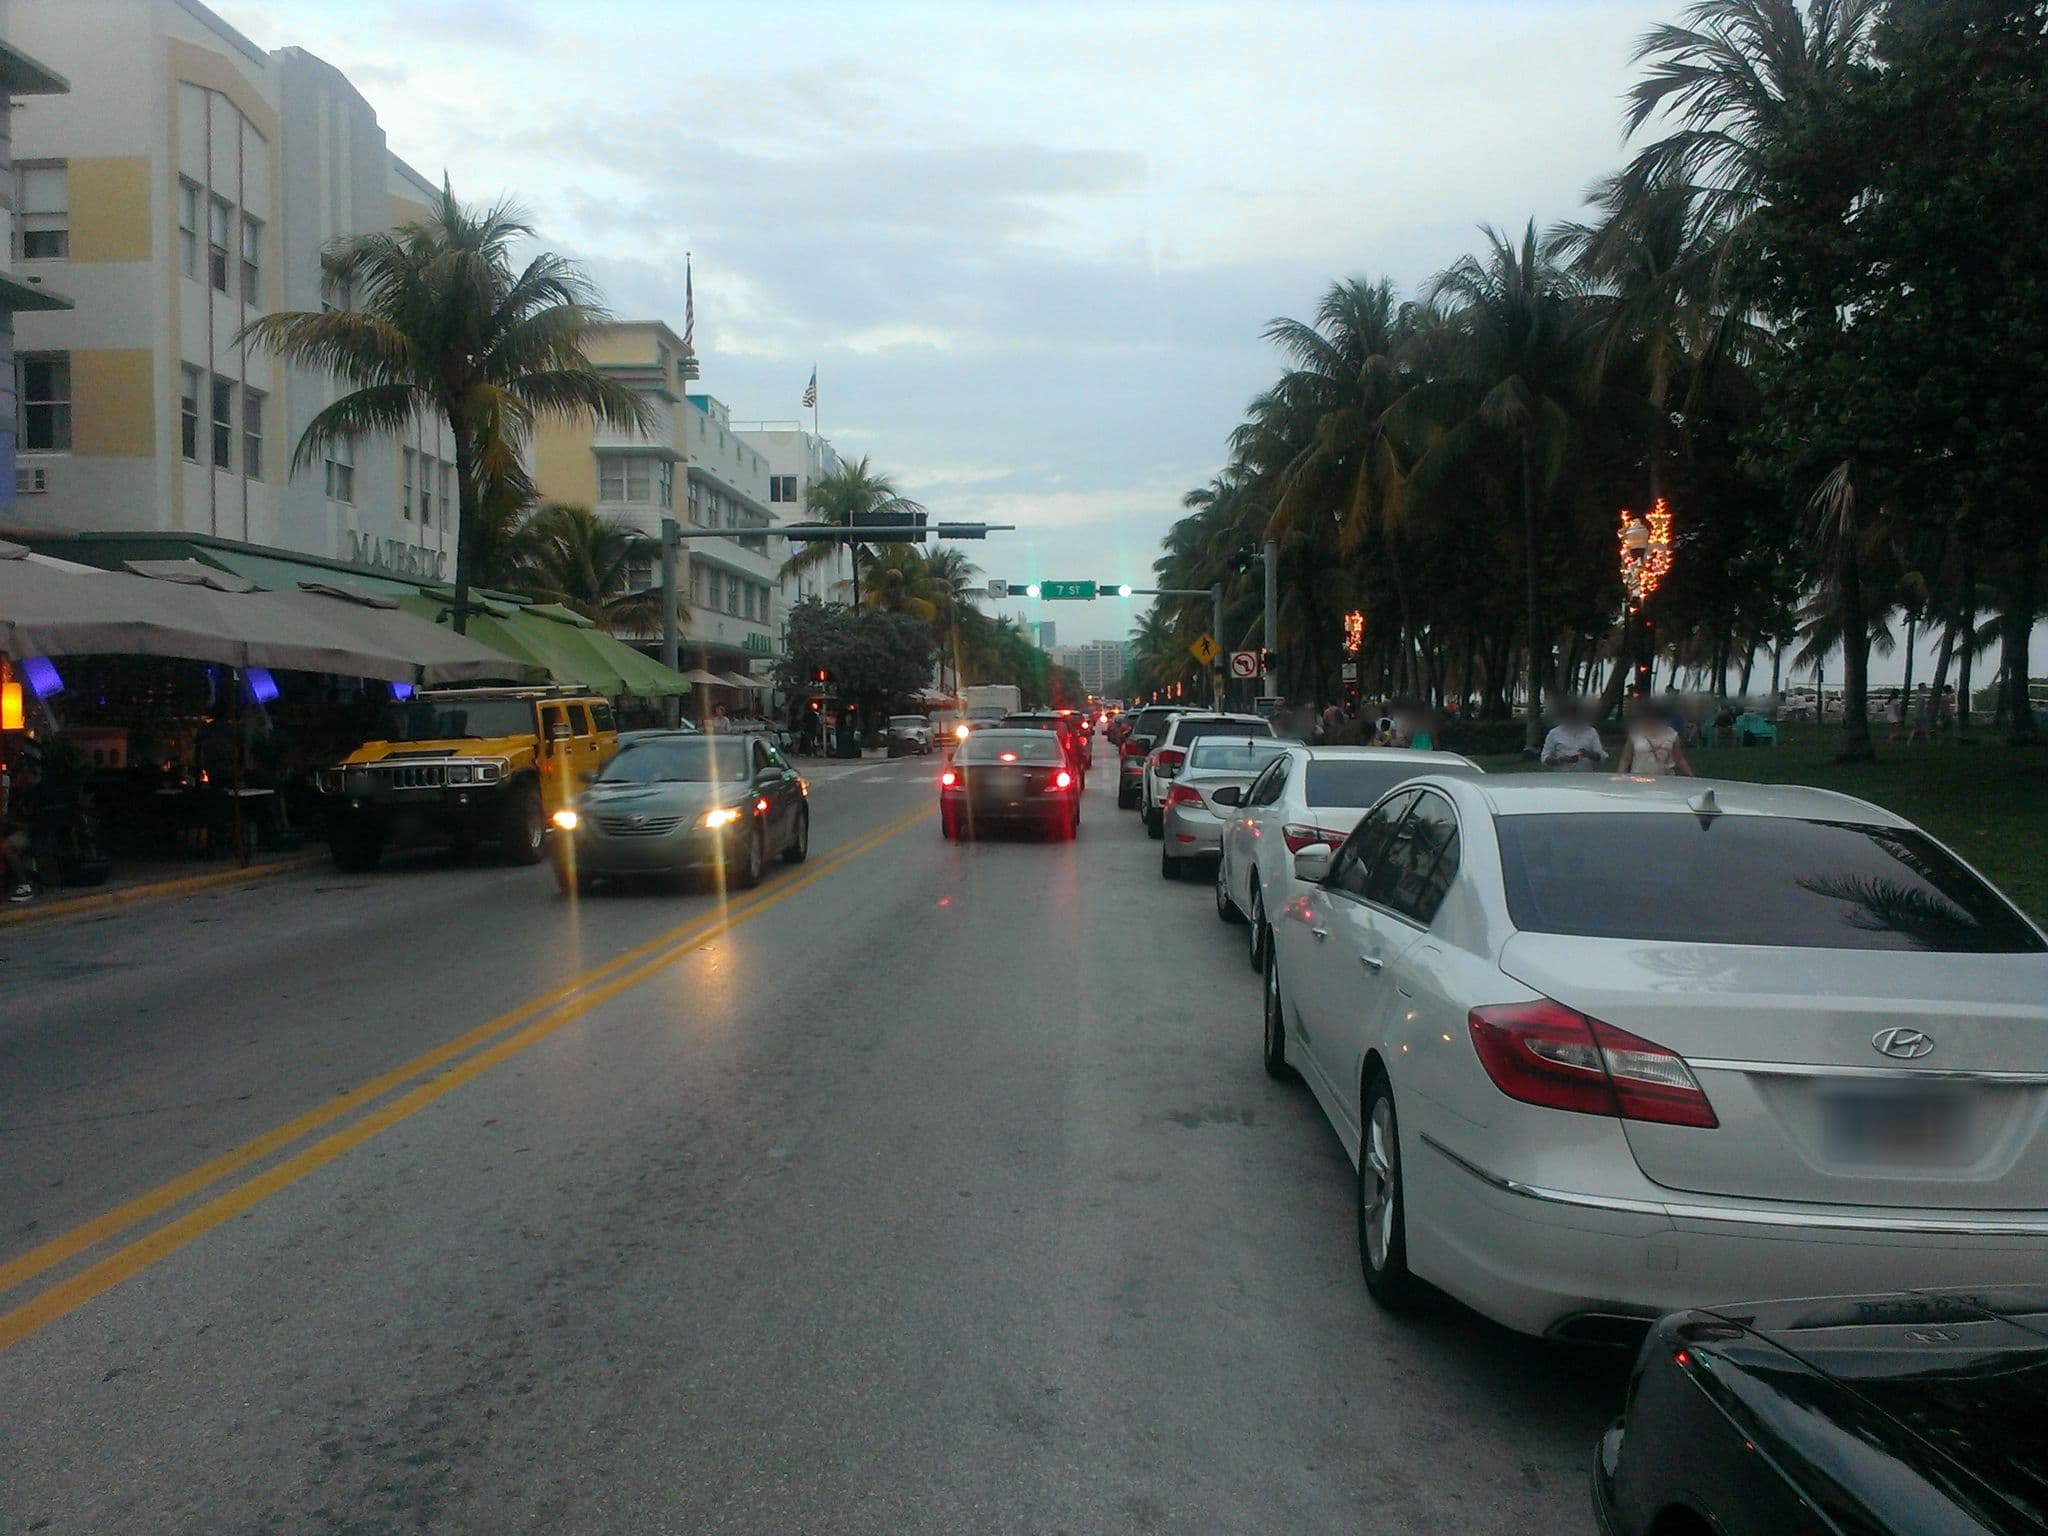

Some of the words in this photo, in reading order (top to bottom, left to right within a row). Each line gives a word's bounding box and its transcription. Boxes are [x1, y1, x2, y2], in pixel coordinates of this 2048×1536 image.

[347, 529, 447, 580] MAJESTIC
[1056, 585, 1064, 595] 7
[1068, 585, 1081, 595] ST
